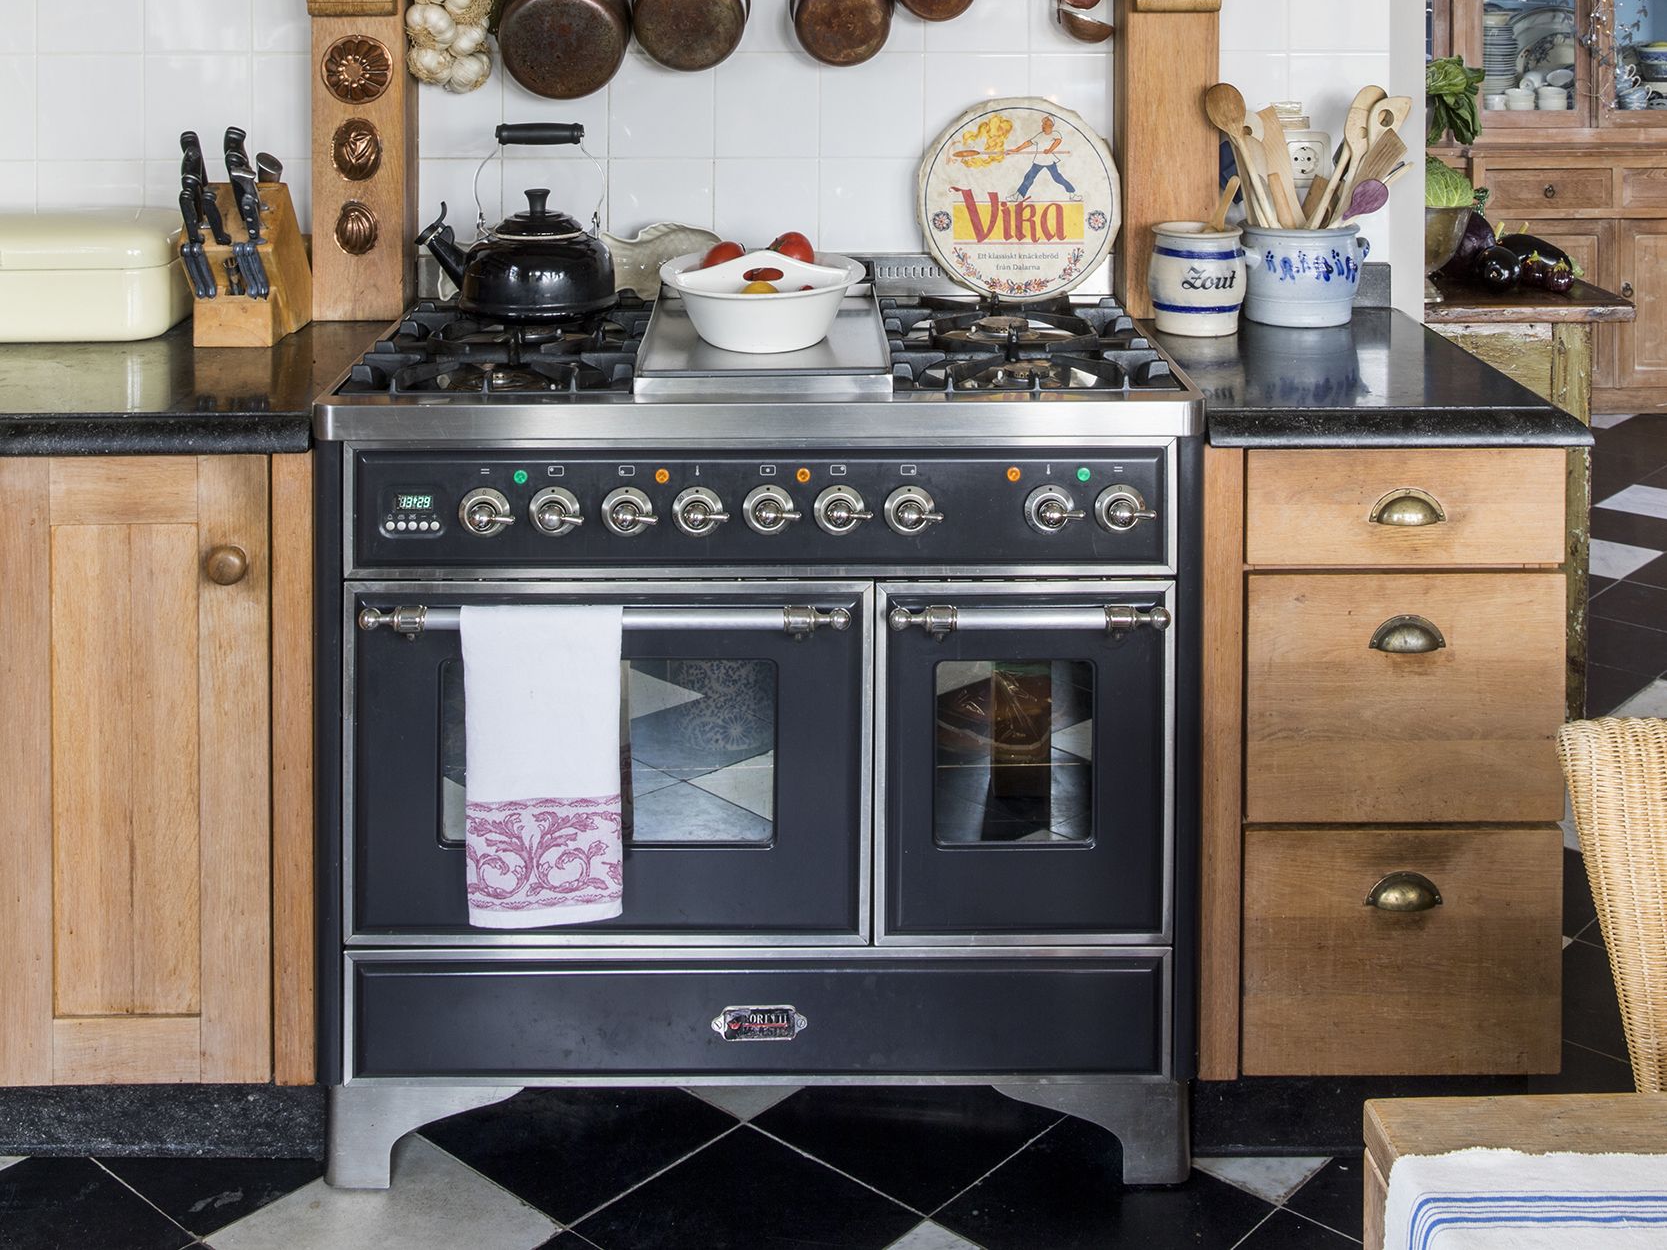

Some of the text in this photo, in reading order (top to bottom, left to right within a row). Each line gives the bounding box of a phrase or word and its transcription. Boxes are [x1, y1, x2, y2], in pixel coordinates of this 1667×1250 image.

[948, 186, 1067, 244] Vika
[977, 252, 1059, 260] Ett klassiskt knäckebröd
[996, 263, 1041, 271] från Dalarna
[1181, 266, 1236, 290] Zout
